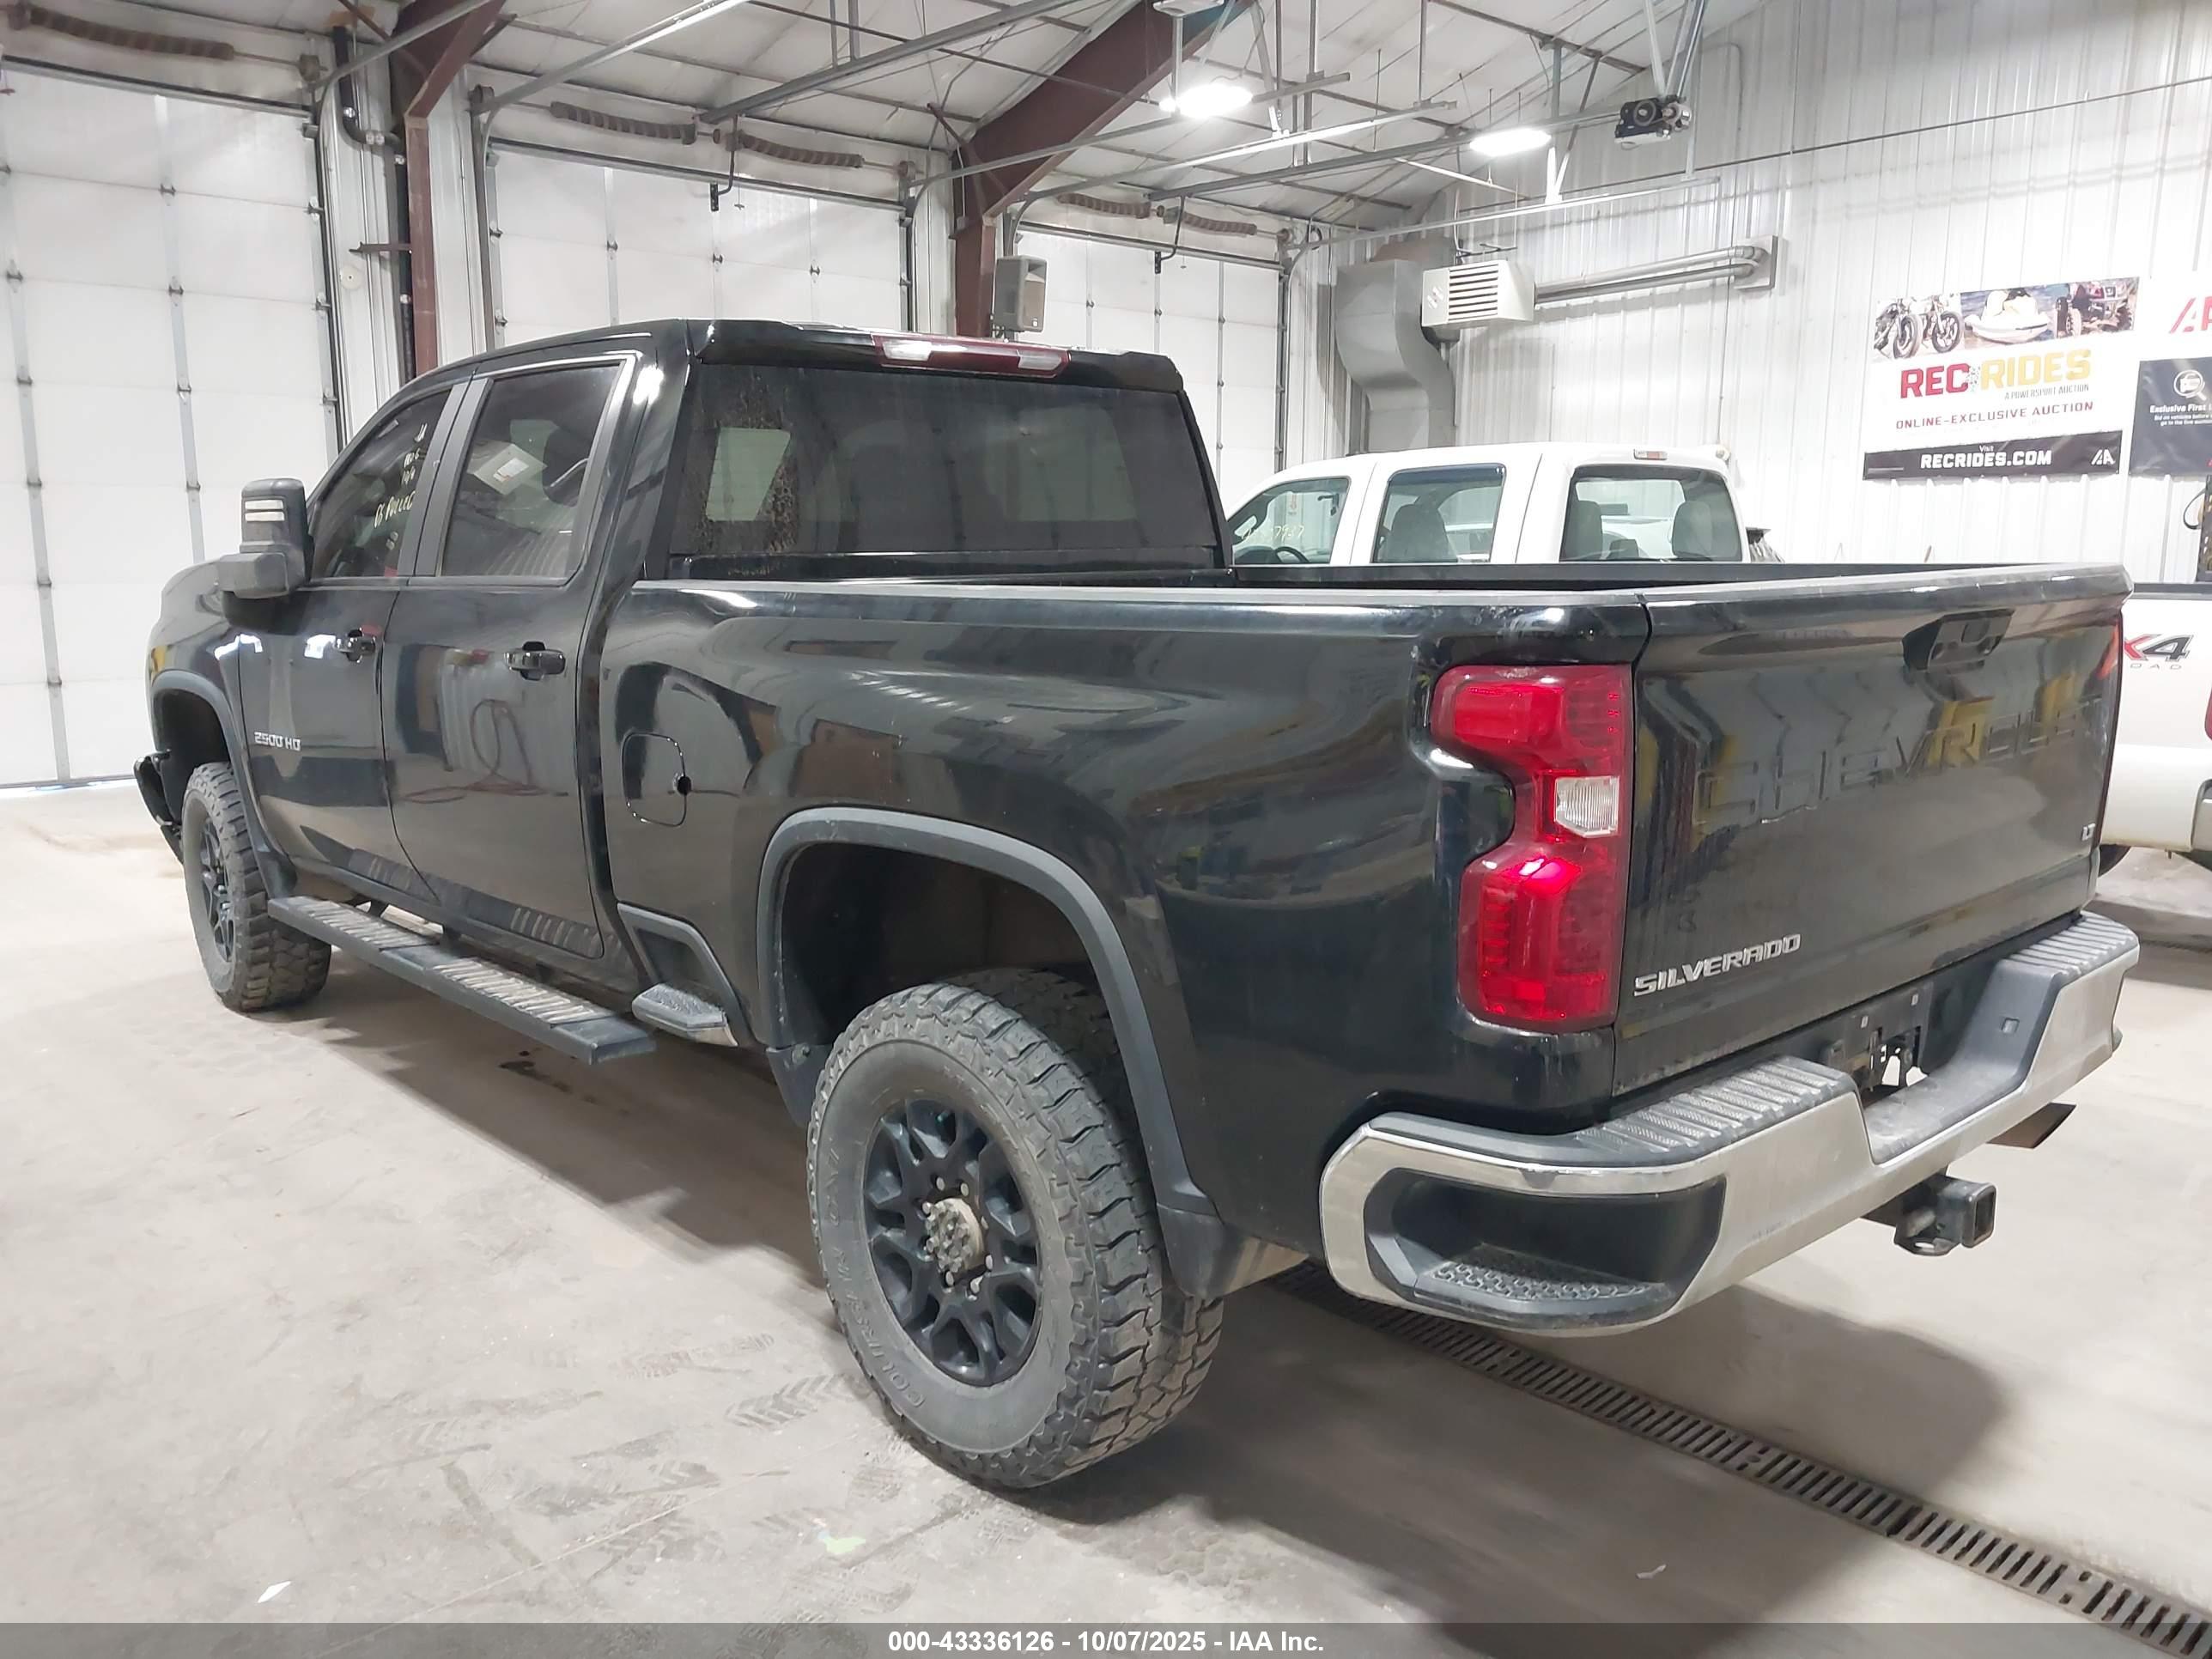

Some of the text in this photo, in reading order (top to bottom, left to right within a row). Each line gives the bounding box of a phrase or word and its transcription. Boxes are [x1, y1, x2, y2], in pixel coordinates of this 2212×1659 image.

[1900, 349, 2092, 398] REC RIDES
[1896, 407, 2027, 429] ONLINE-EXCLUSIVE
[2032, 401, 2094, 416] AUCTION
[1920, 450, 2052, 469] RECRIDES.COM
[1979, 445, 1995, 453] Visit
[254, 731, 301, 752] 2500 HD
[1633, 933, 1802, 997] SILVERADO
